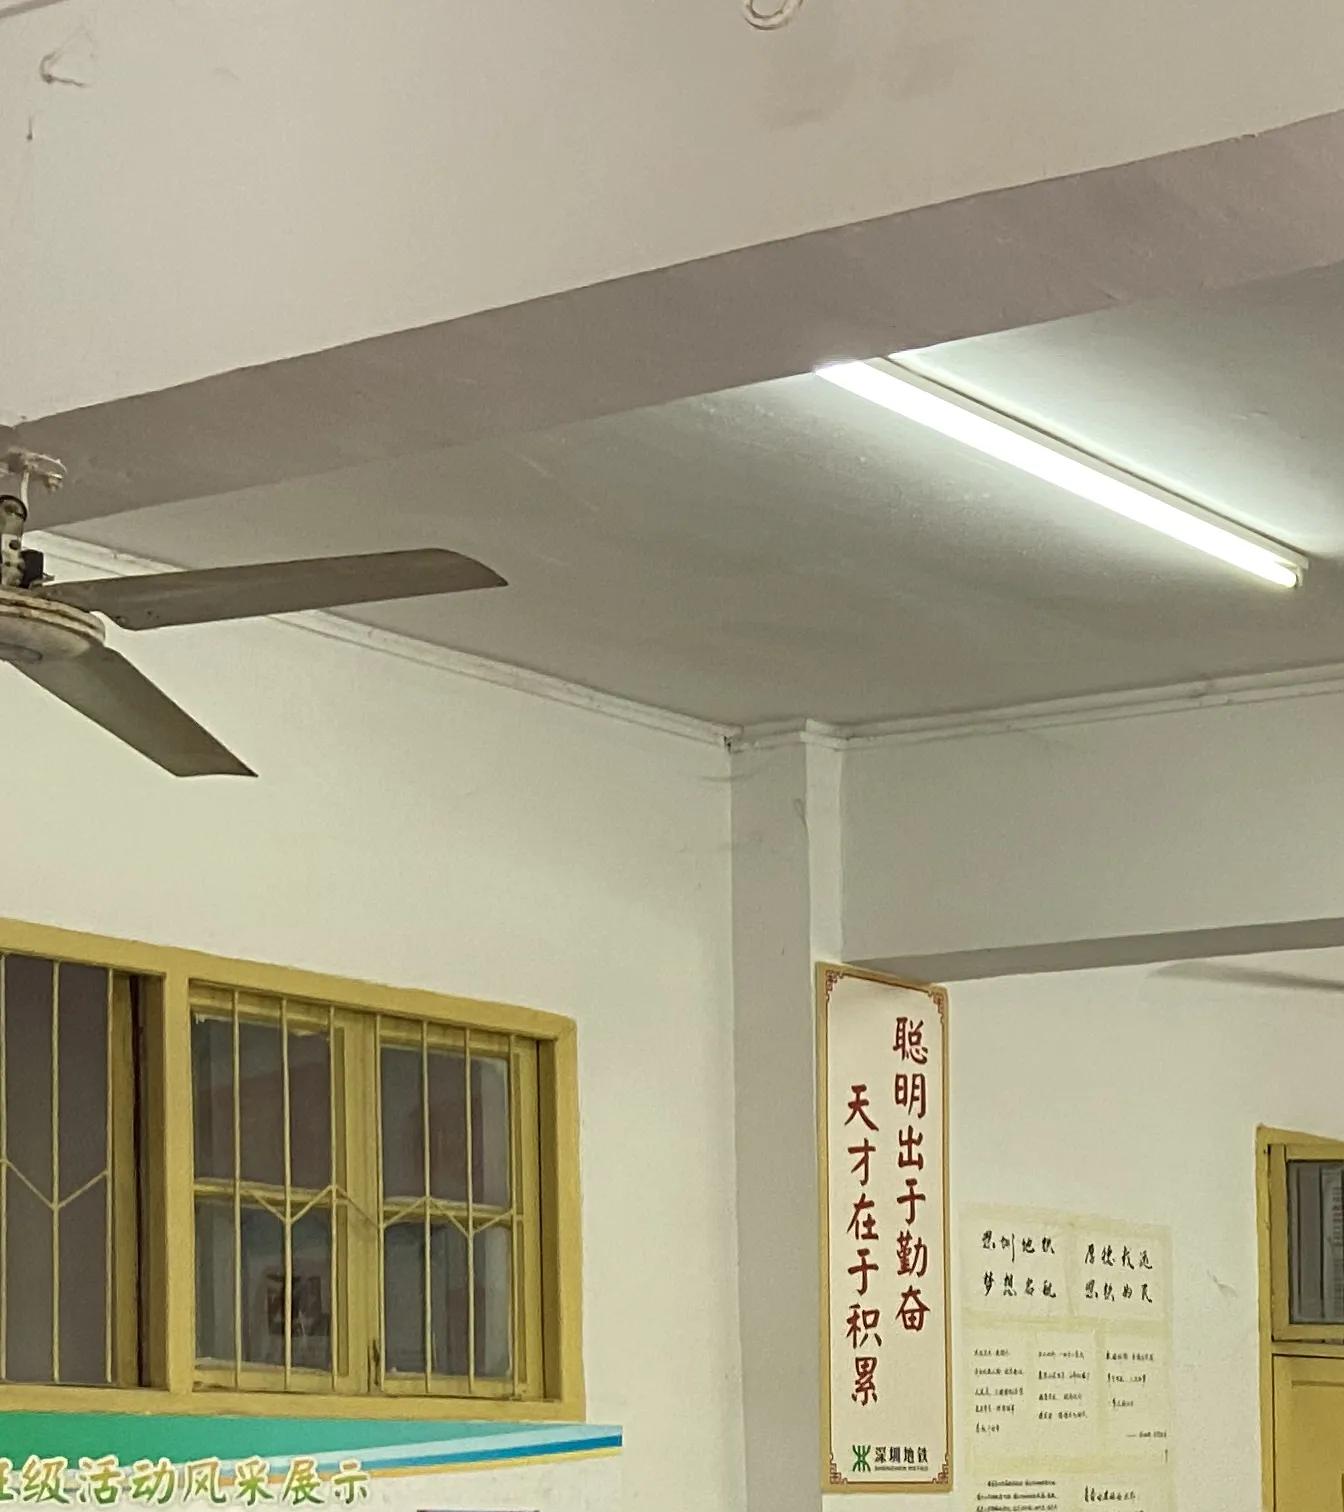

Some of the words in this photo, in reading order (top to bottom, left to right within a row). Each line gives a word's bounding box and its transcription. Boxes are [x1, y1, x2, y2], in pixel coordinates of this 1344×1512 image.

[844, 1083, 882, 1406] 天才在于积累
[892, 1016, 931, 1333] 聪明出于勤奋
[875, 1446, 928, 1463] 深圳地铁
